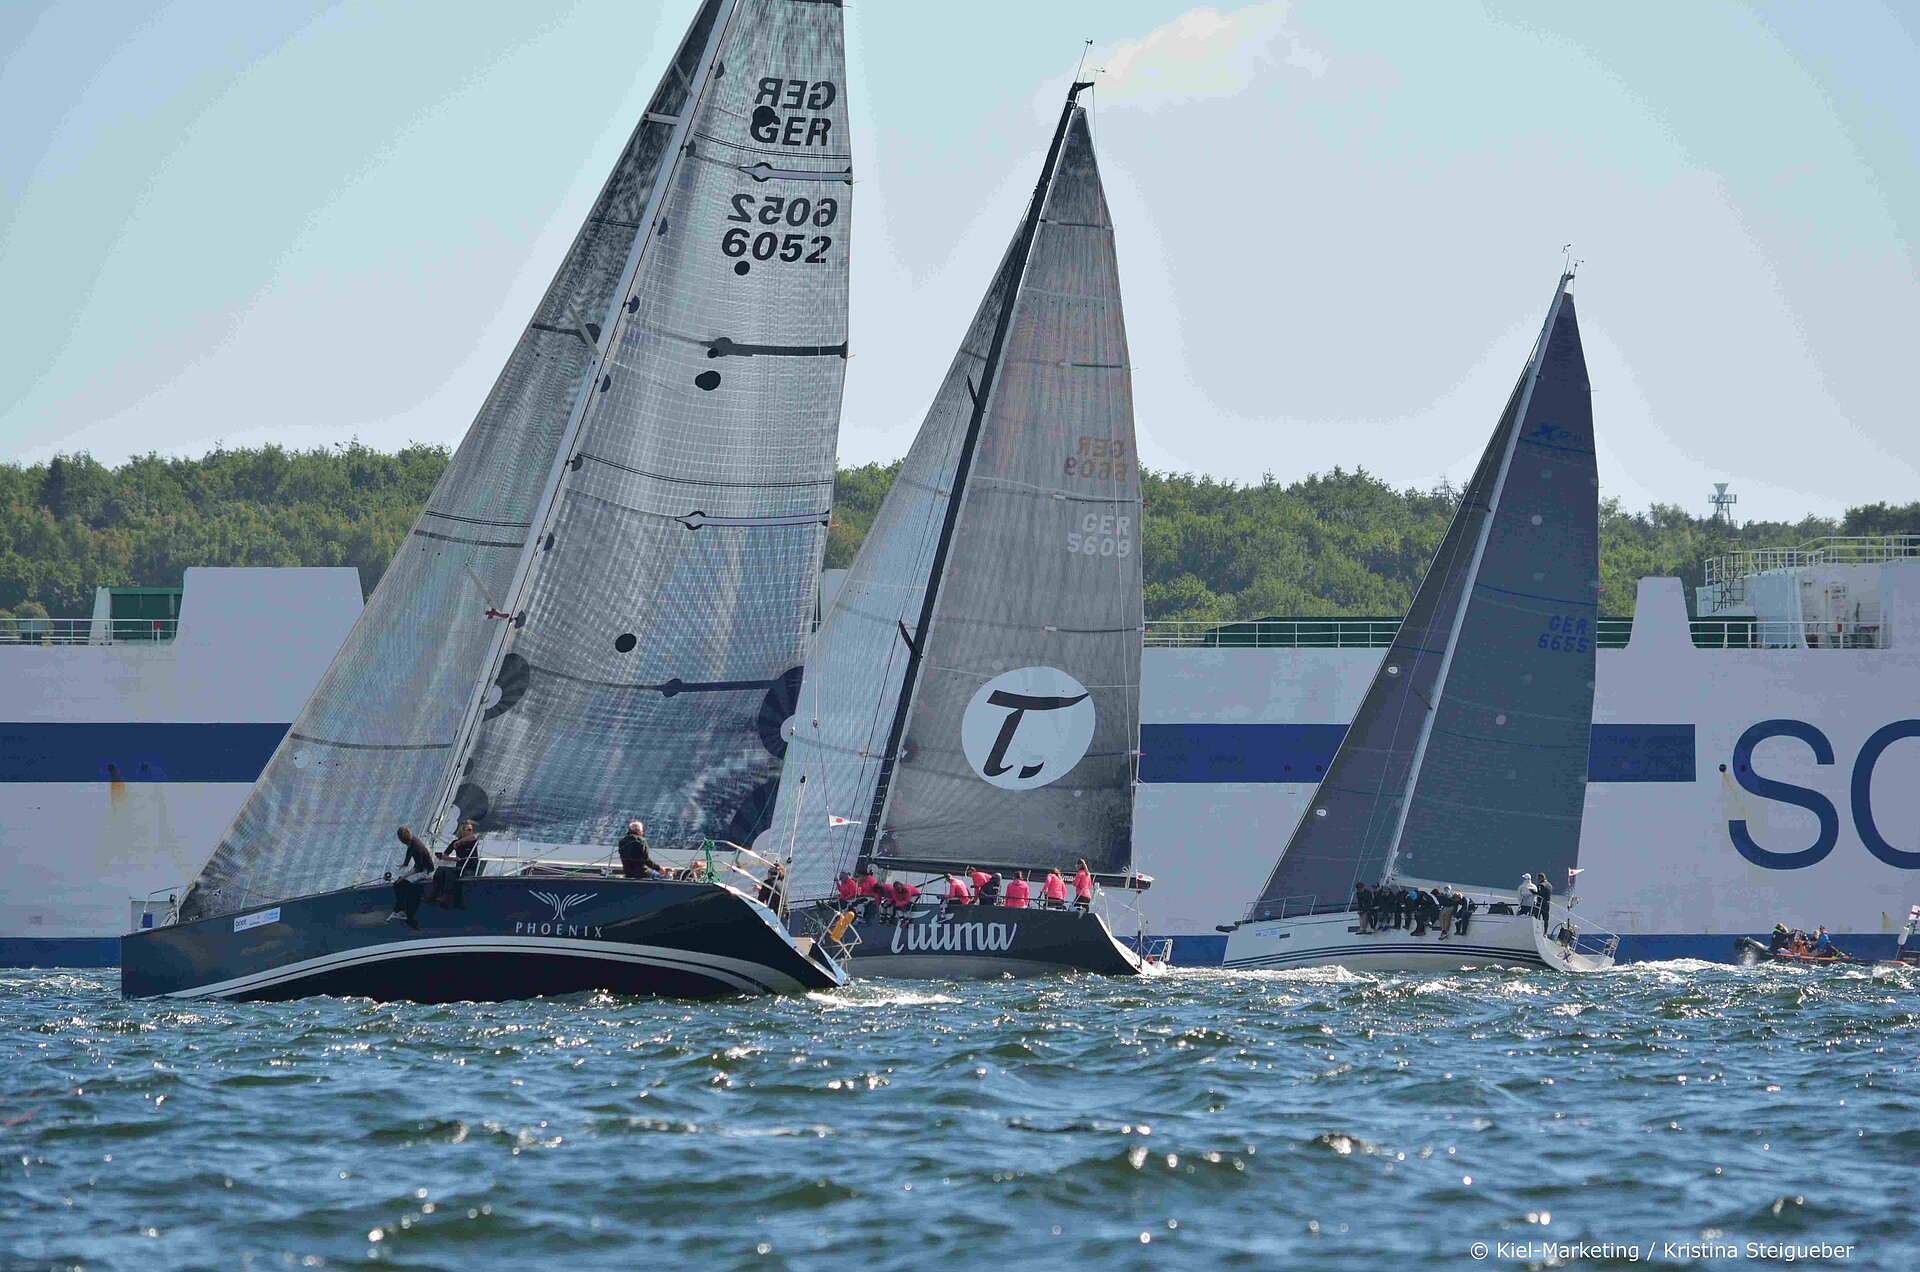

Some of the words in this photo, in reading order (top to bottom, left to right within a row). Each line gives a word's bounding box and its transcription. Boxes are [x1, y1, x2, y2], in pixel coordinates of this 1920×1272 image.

[750, 115, 832, 146] GER
[721, 228, 832, 263] 6052
[1082, 513, 1131, 536] GER
[1066, 532, 1132, 558] 5609
[1549, 615, 1588, 634] GER
[515, 921, 602, 938] PHOENIX
[890, 909, 1018, 954] Tutima
